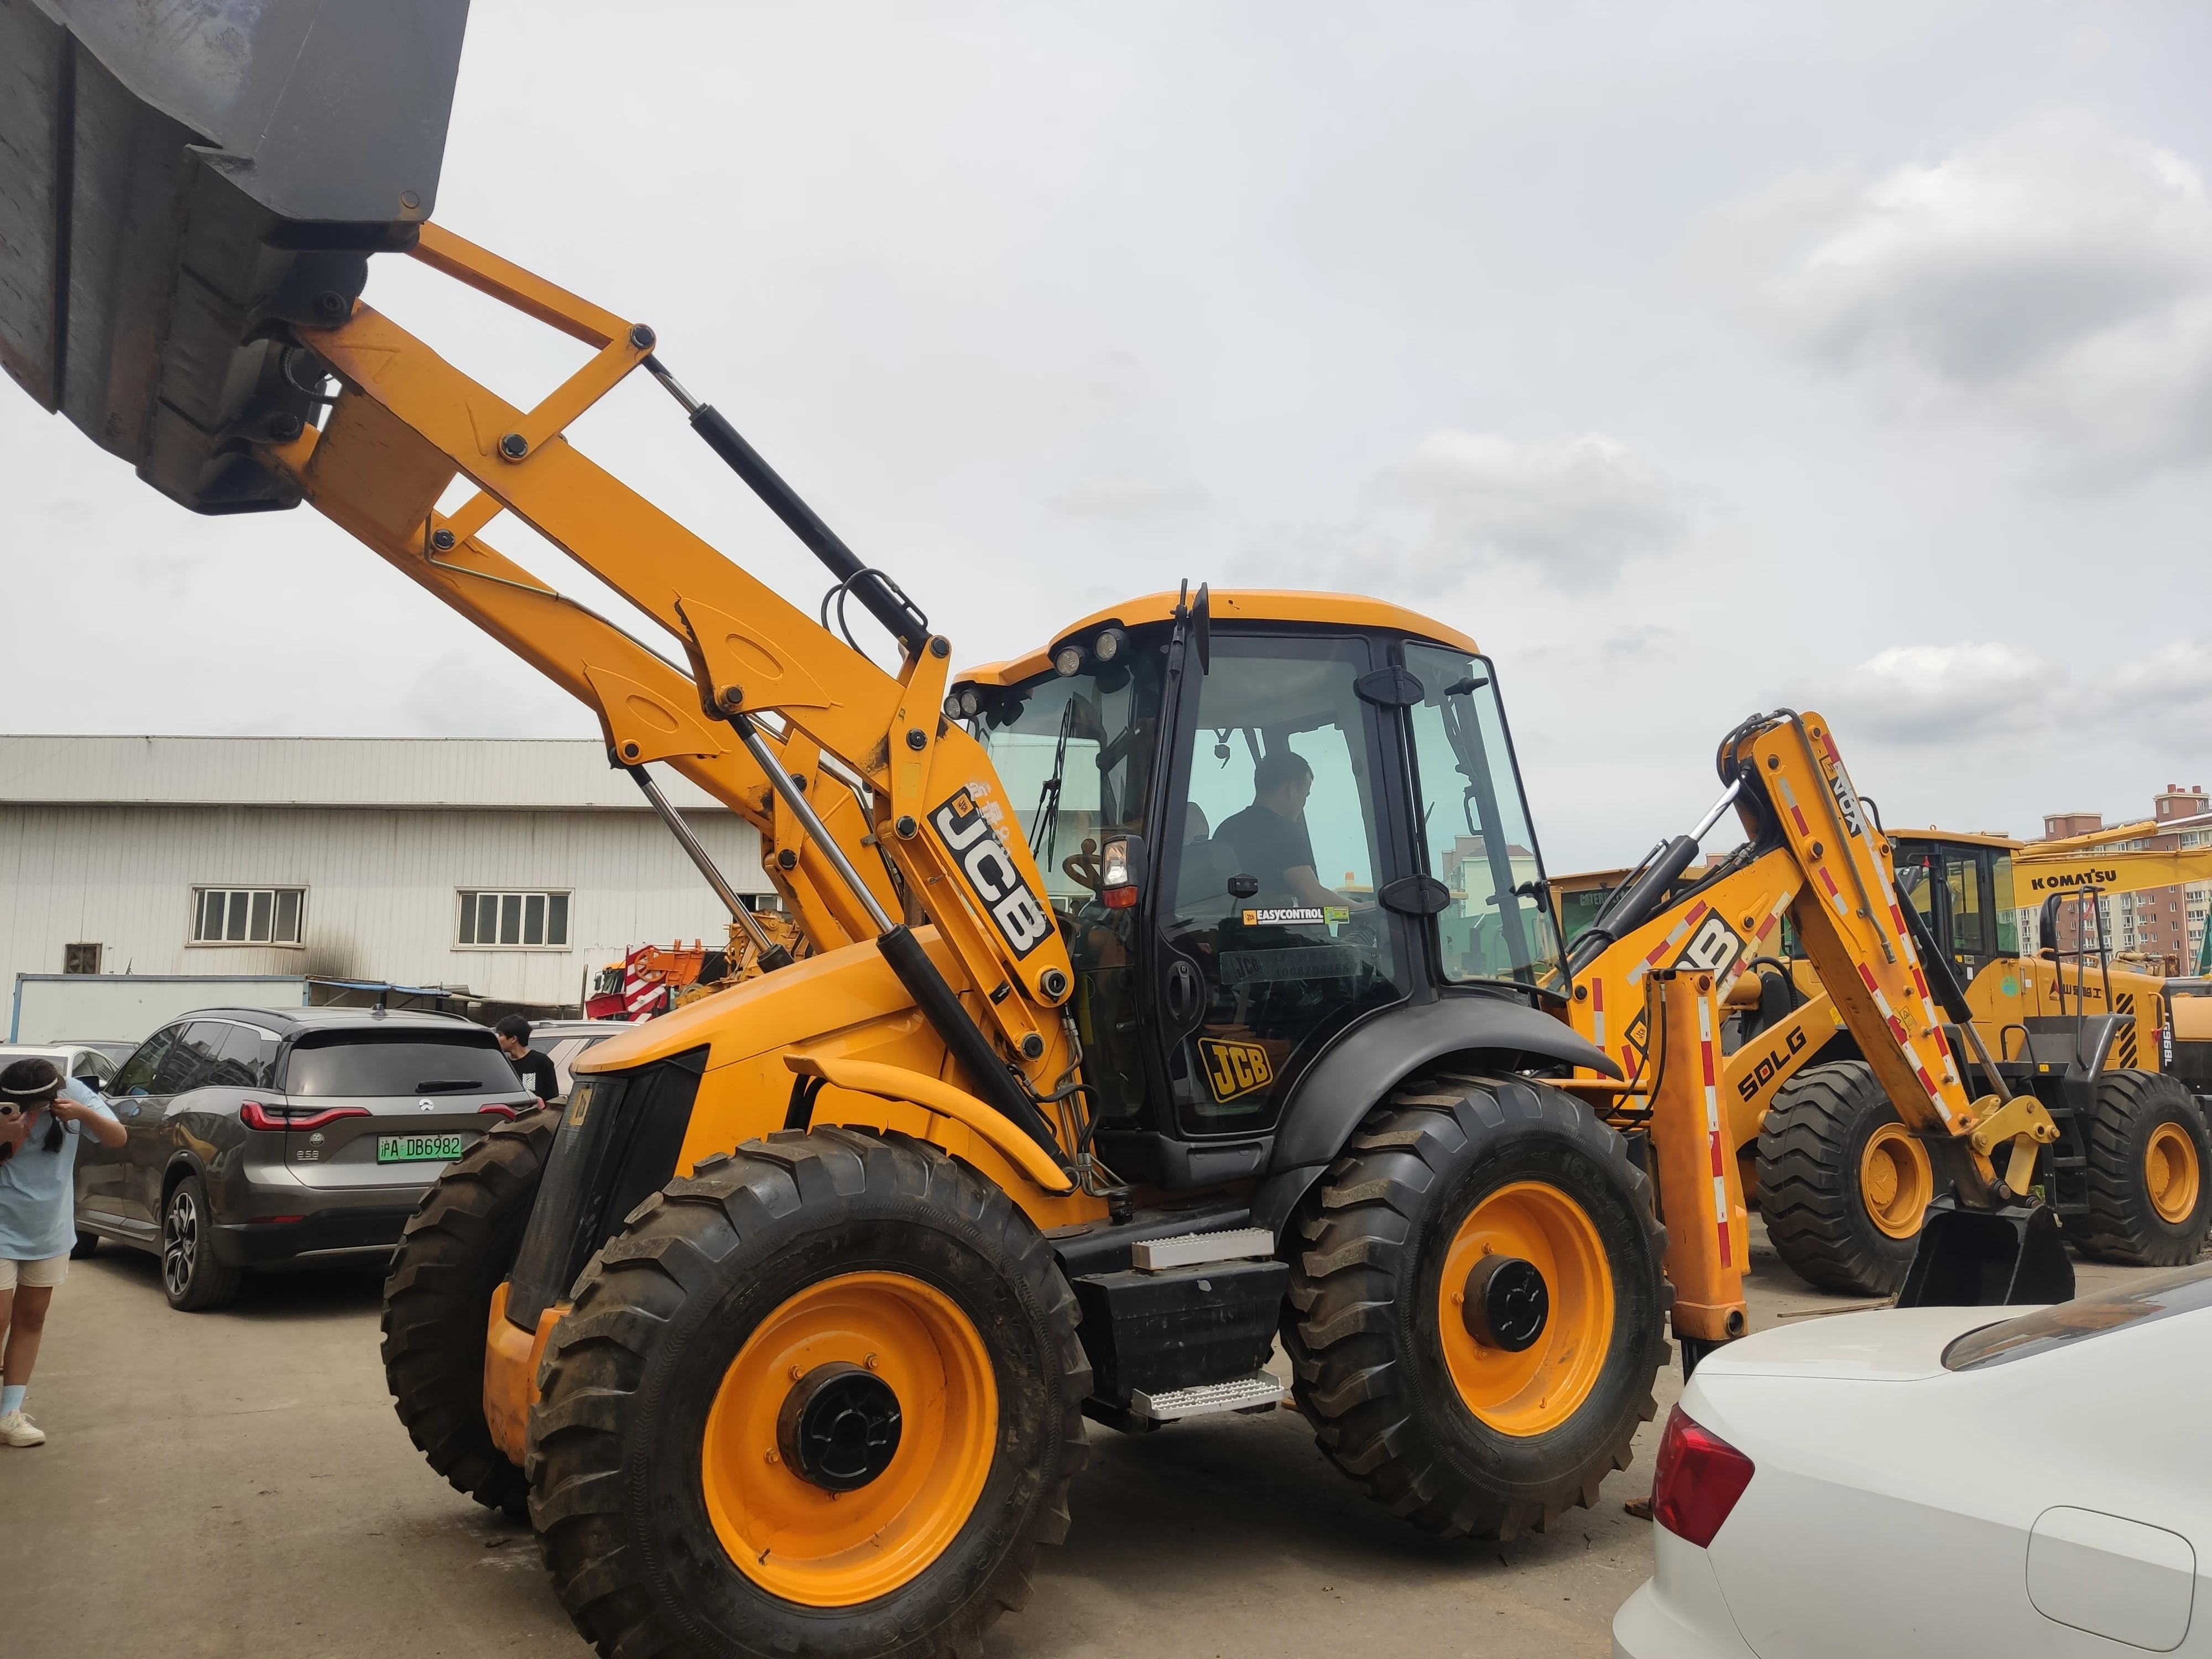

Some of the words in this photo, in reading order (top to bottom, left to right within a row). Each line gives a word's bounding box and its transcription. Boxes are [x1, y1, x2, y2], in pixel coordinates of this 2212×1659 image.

[936, 807, 1047, 951] JCB
[2031, 868, 2117, 890] KOMATSU
[1257, 908, 1323, 921] EASYCONTROL
[1233, 956, 1261, 979] JCB
[1211, 1044, 1268, 1095] JCB
[1737, 1025, 1807, 1103] SDLG
[406, 1138, 460, 1156] DB6982
